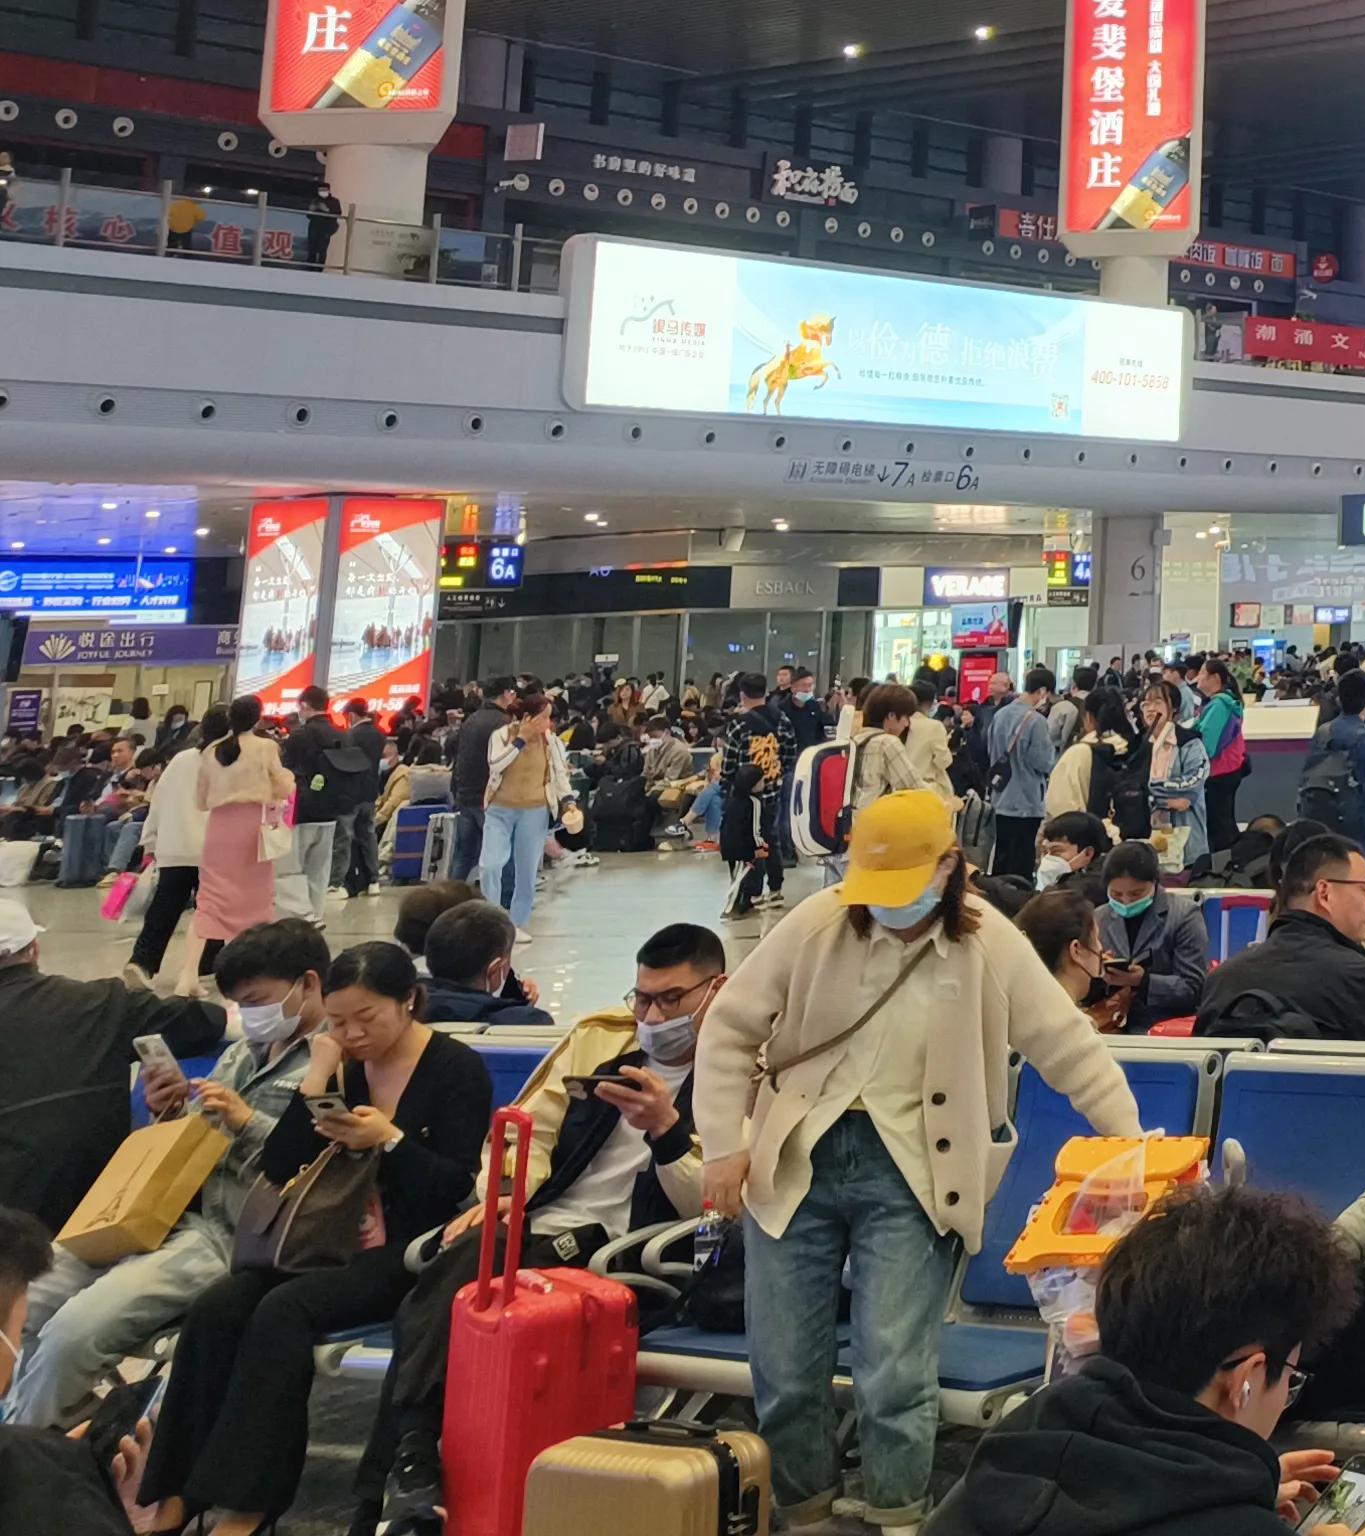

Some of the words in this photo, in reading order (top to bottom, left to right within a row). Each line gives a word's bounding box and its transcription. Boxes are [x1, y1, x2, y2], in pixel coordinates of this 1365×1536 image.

[1019, 213, 1063, 241] 吉仕
[891, 462, 915, 488] 7A
[956, 464, 980, 490] 6A
[490, 558, 516, 580] 6A
[1131, 555, 1146, 581] 6
[755, 580, 815, 596] ESBACK
[931, 575, 1006, 598] VERAGE
[78, 632, 155, 648] 悦途出行
